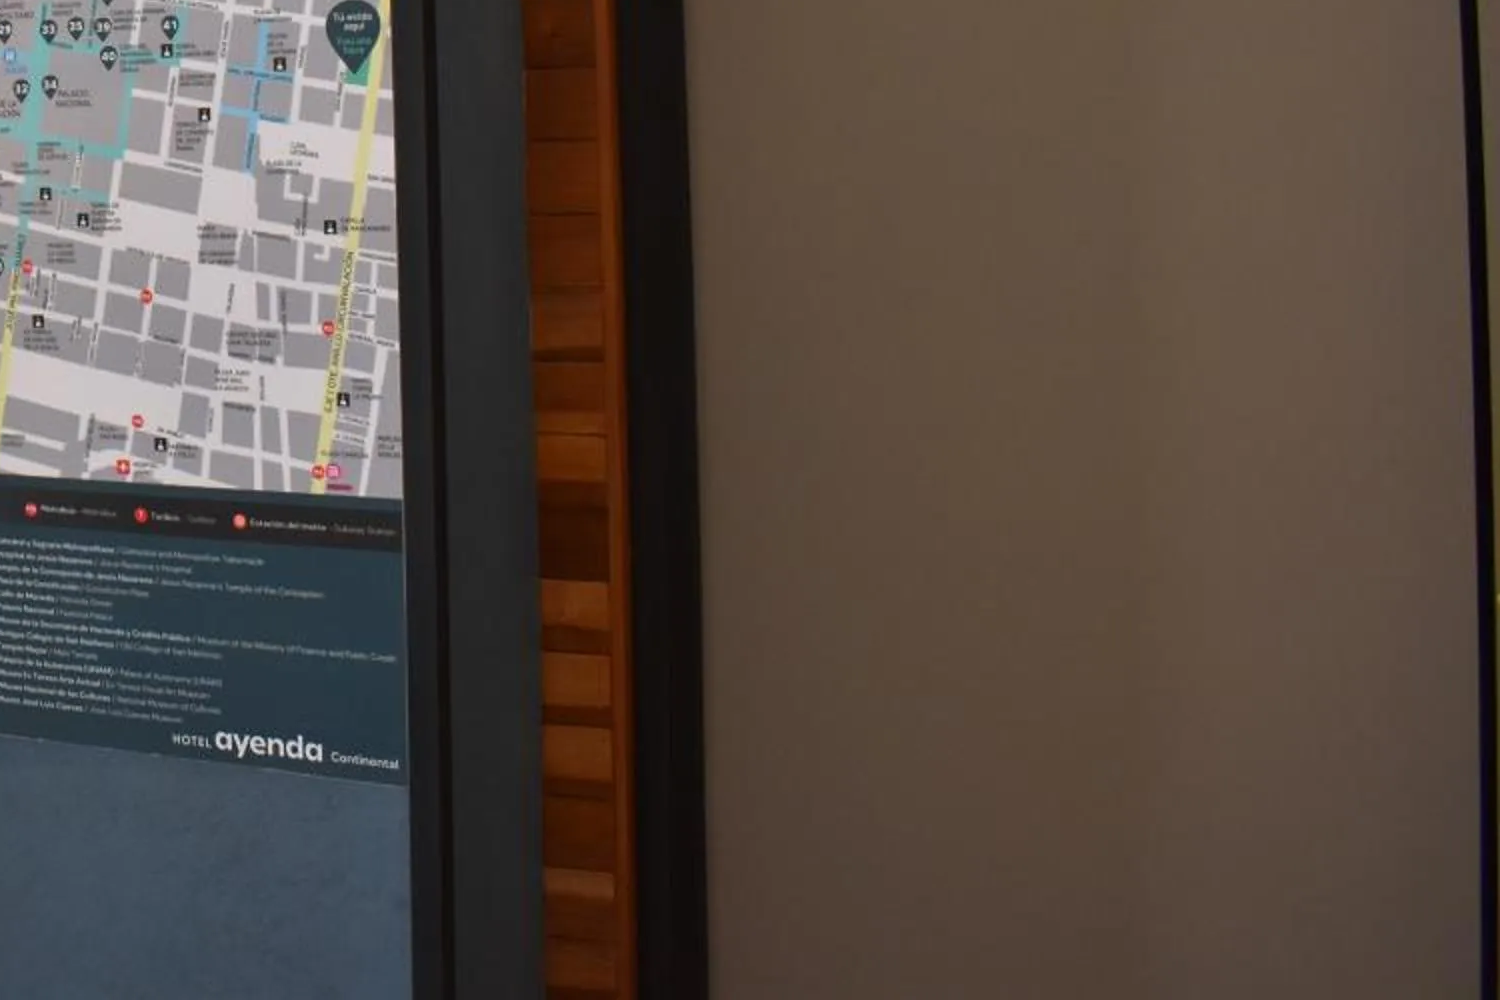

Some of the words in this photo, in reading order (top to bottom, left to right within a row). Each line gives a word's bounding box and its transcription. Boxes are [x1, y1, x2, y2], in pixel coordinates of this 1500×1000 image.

[172, 732, 212, 749] HOTEL
[215, 730, 324, 764] ayenda
[330, 751, 399, 770] Continental
